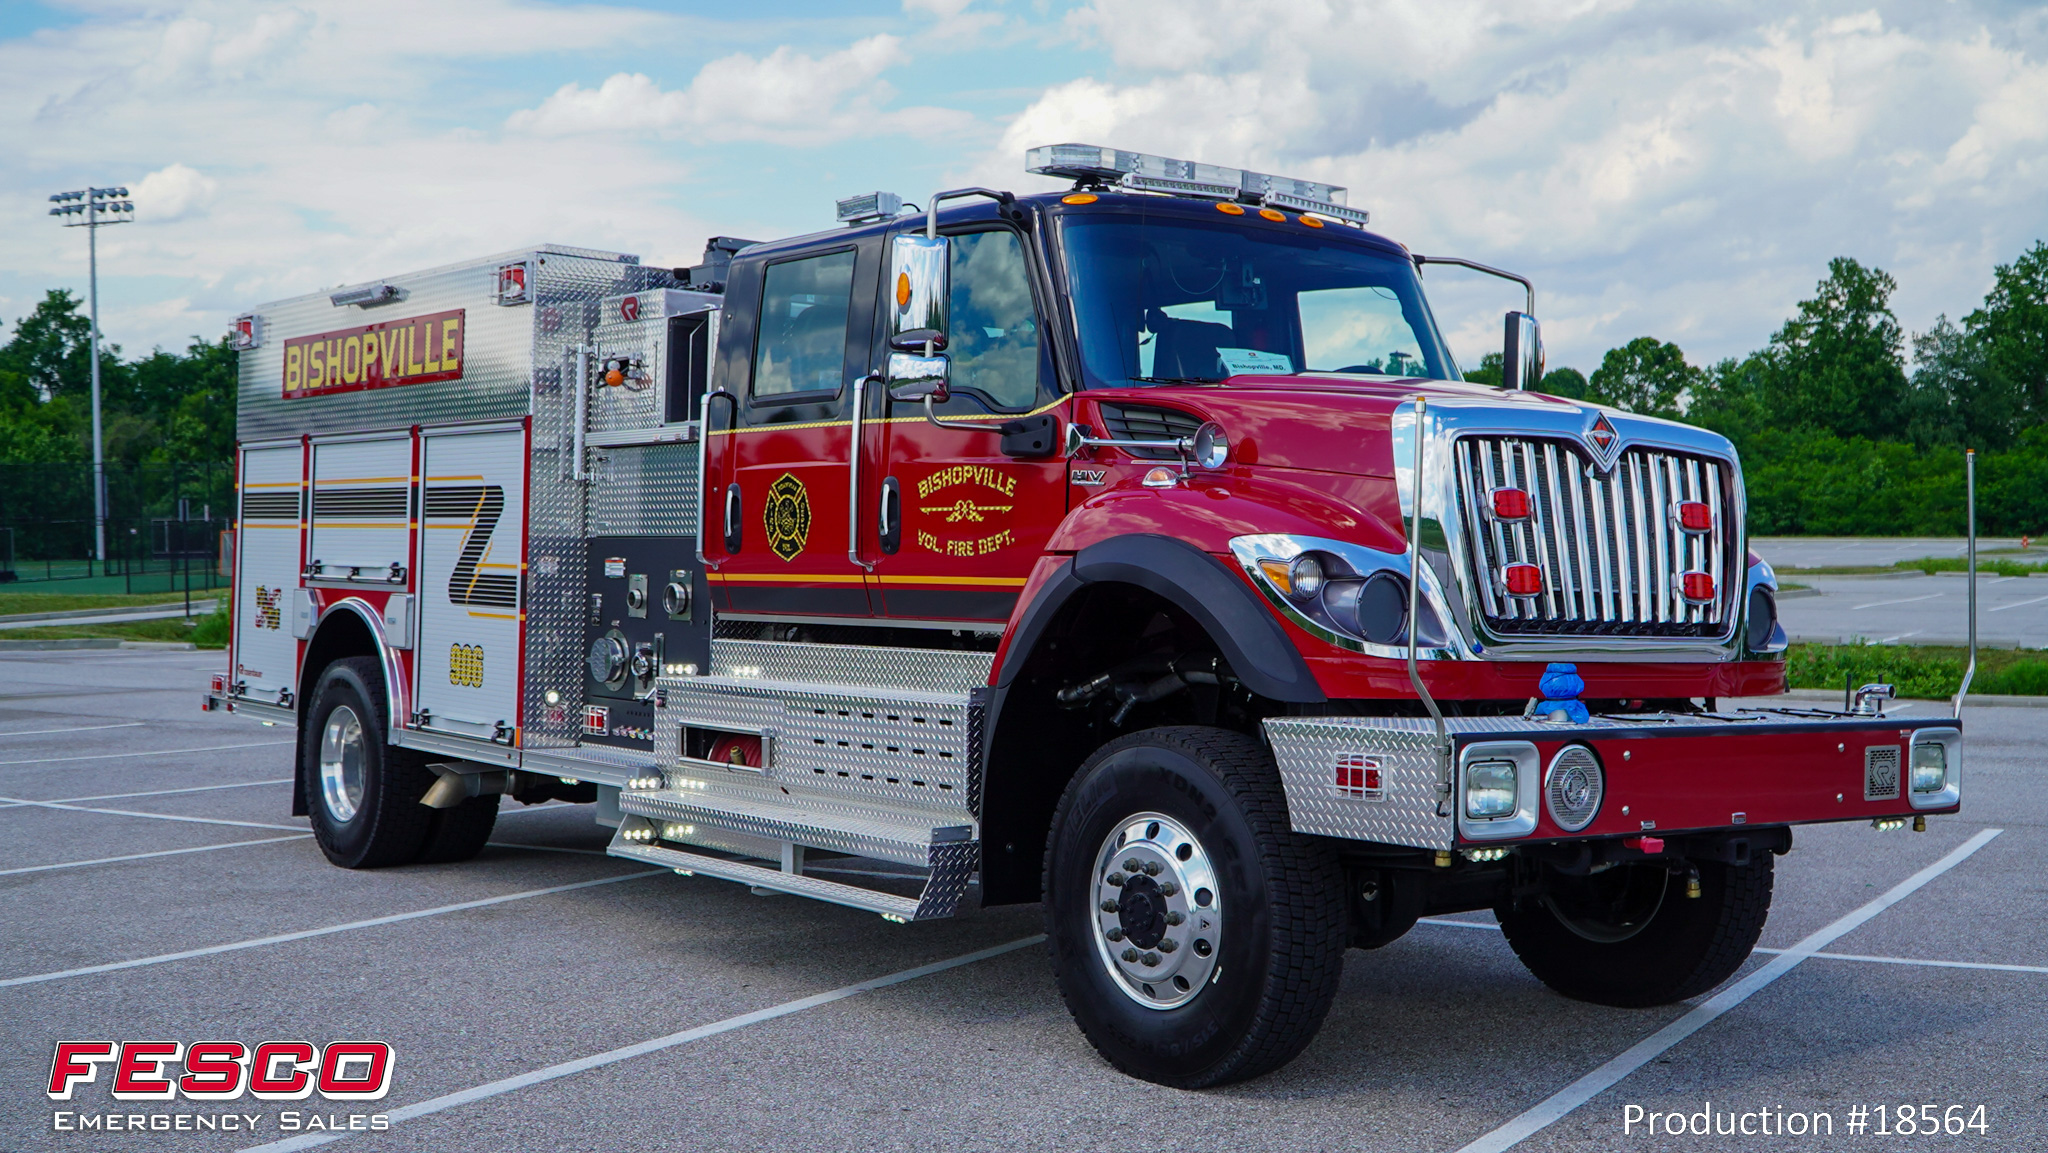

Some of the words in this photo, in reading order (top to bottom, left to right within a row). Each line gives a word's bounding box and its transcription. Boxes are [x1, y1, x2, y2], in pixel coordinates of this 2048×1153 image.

[285, 318, 459, 392] BISHOPVILLE
[917, 465, 1017, 499] BISHOPVILLE
[1072, 470, 1105, 482] HV
[917, 528, 943, 554] VOL.
[946, 540, 975, 556] FIRE
[977, 528, 1015, 555] DEPT.
